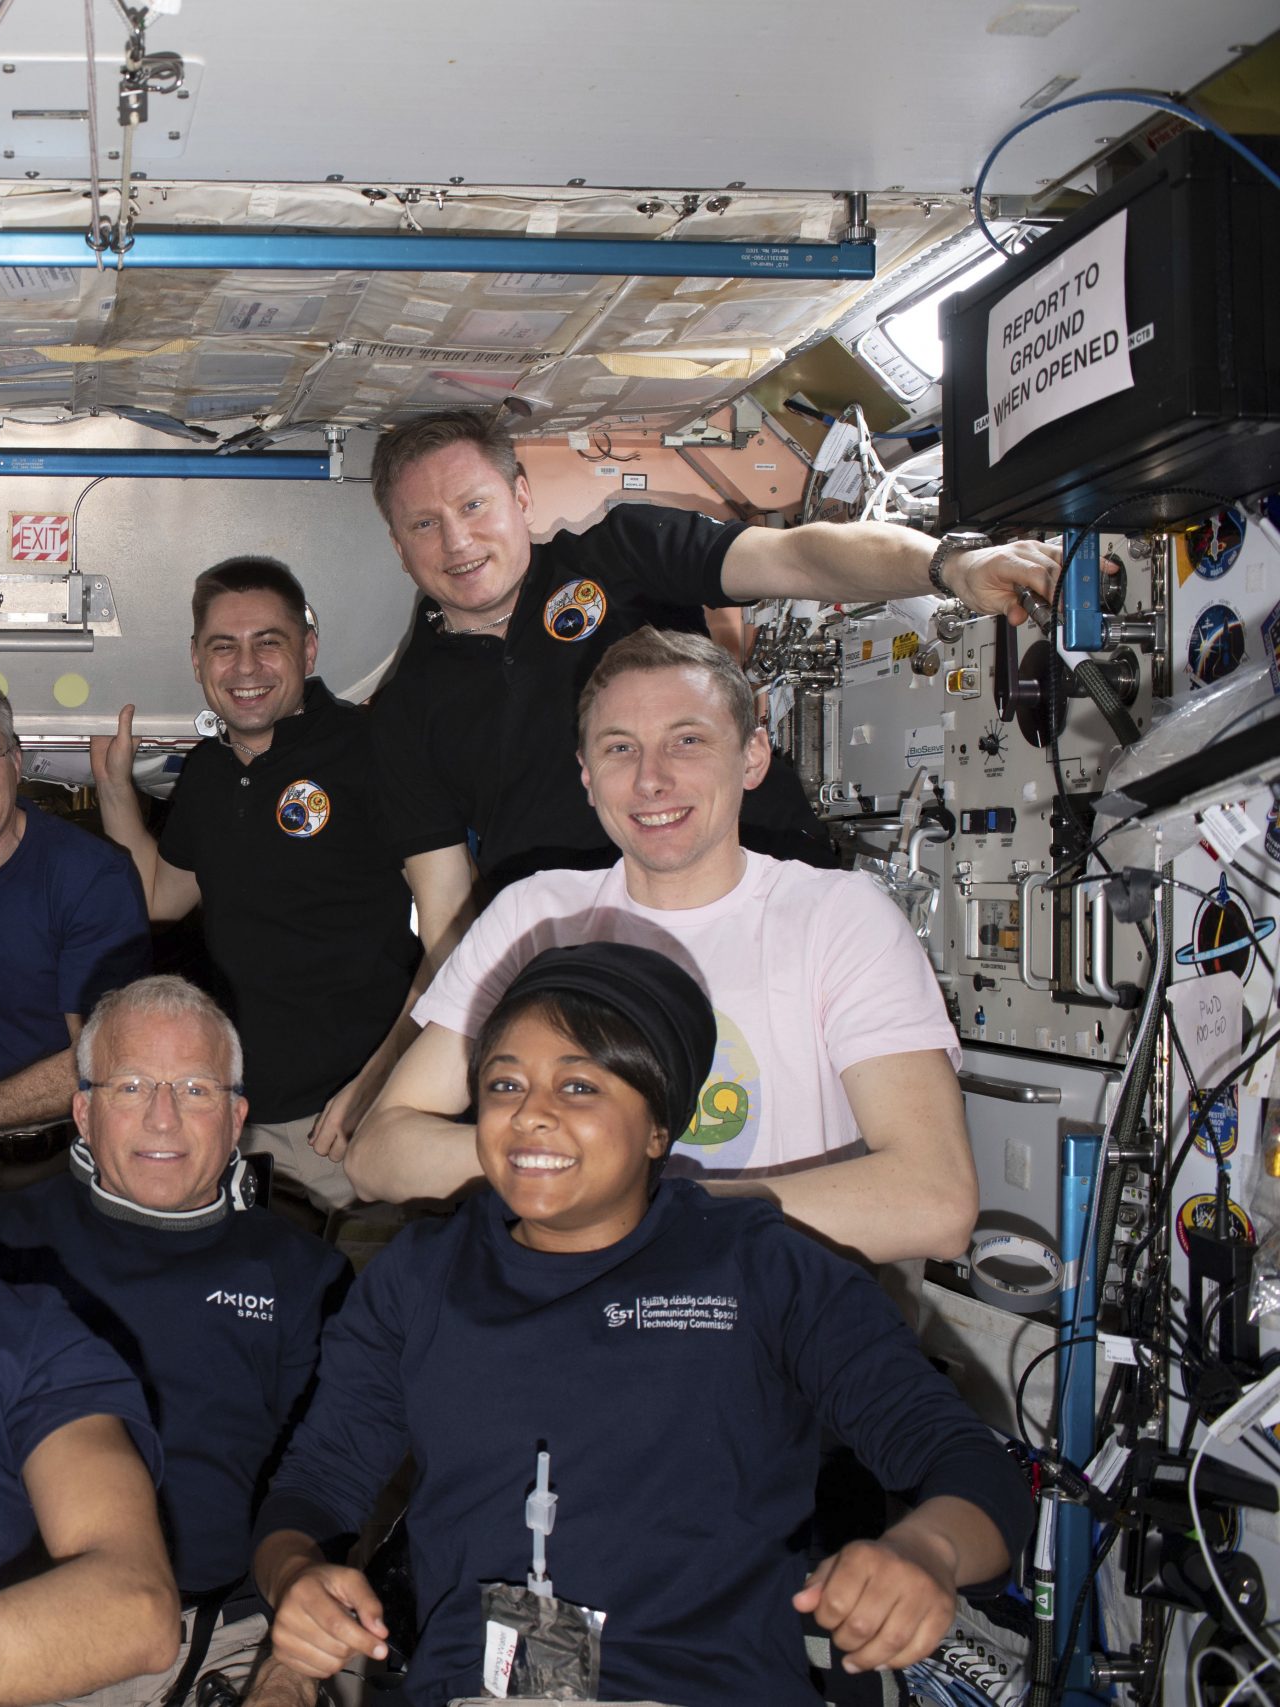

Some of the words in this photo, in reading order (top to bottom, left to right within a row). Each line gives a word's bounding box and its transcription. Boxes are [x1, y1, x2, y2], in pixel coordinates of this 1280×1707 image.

[1002, 281, 1069, 349] REPORT
[1074, 262, 1100, 298] TO
[1010, 308, 1085, 376] GROUND
[1136, 328, 1151, 343] CTB
[993, 378, 1031, 428] WHEN
[1035, 329, 1119, 394] OPENED
[21, 526, 60, 550] EXIT
[1199, 995, 1221, 1018] PWD
[206, 1290, 274, 1311] AXIOM
[237, 1309, 273, 1322] SPACE
[641, 1307, 712, 1319] Communications,
[643, 1318, 688, 1330] Technology
